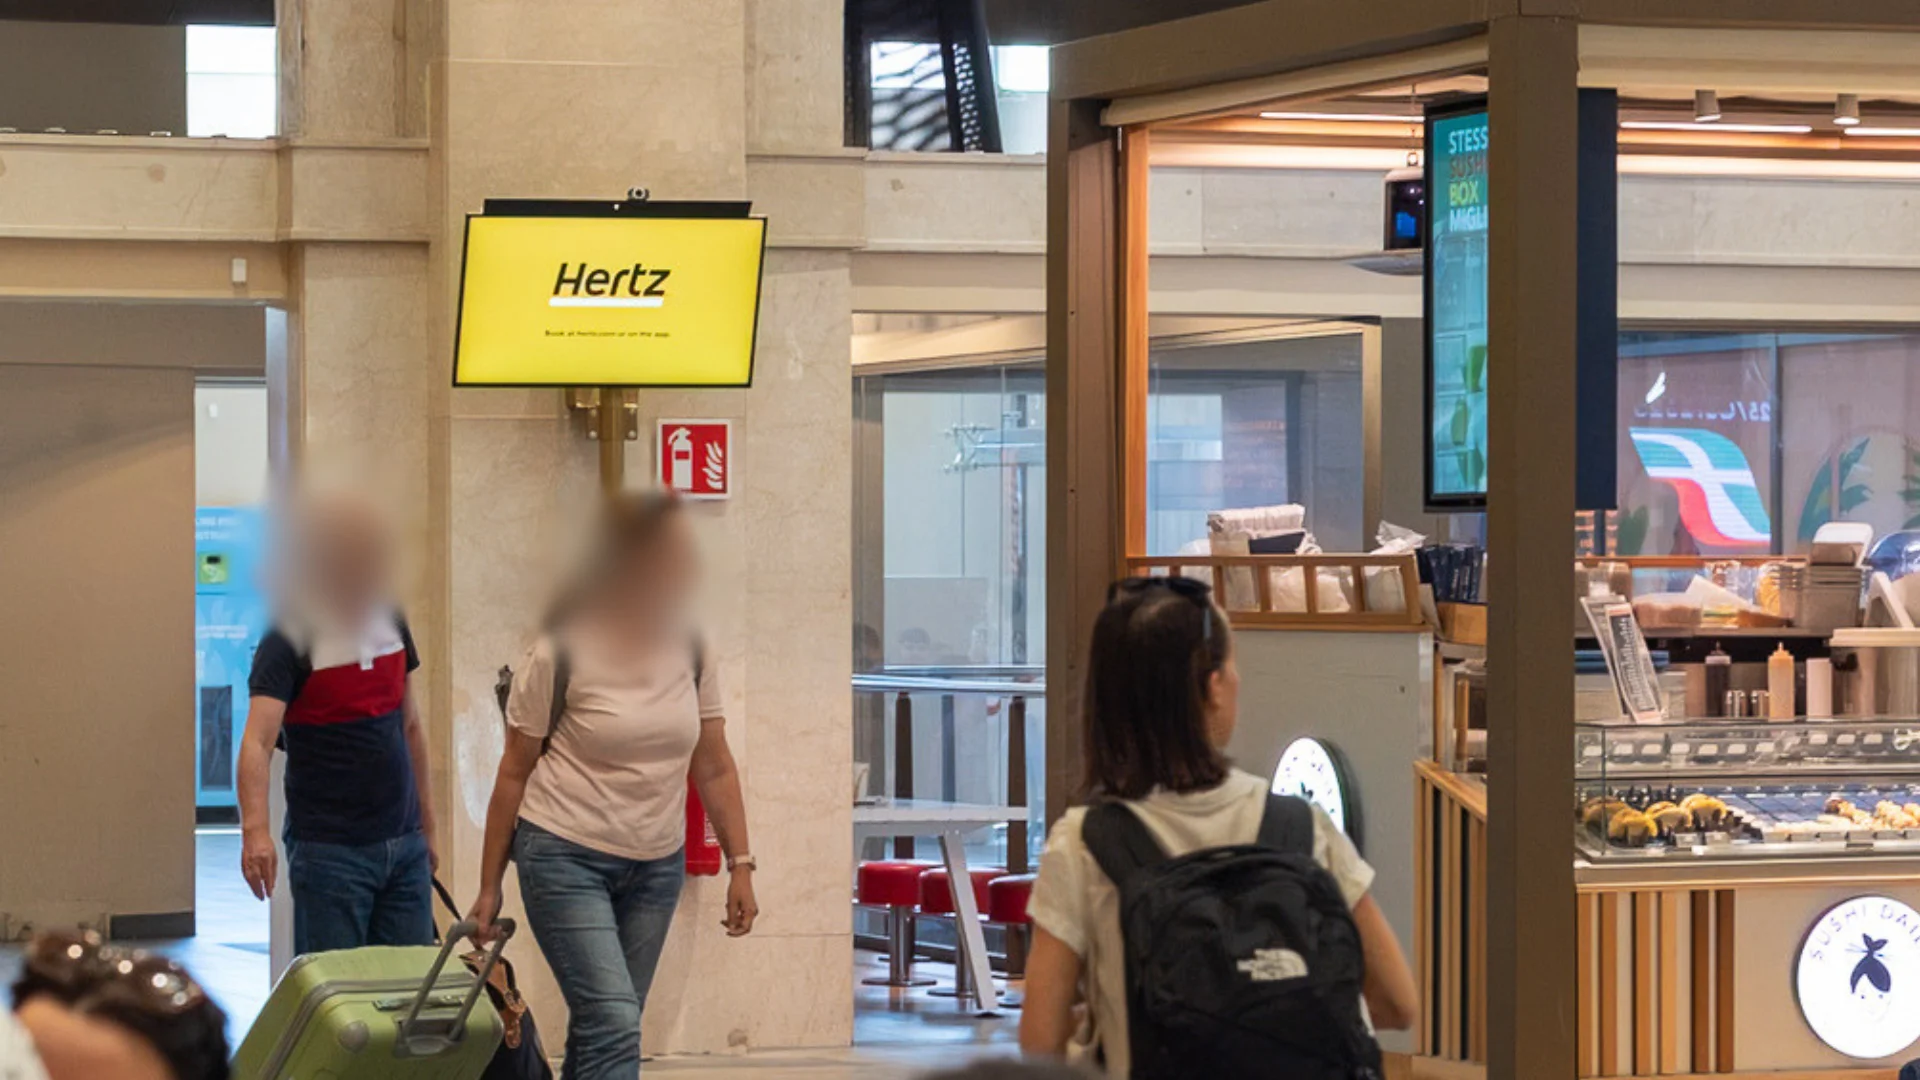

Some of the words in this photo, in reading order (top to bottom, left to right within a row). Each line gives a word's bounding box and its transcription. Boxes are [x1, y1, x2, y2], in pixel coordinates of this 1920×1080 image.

[1449, 180, 1479, 207] BOX
[552, 262, 672, 297] Hertz
[1810, 903, 1868, 962] SUSHI
